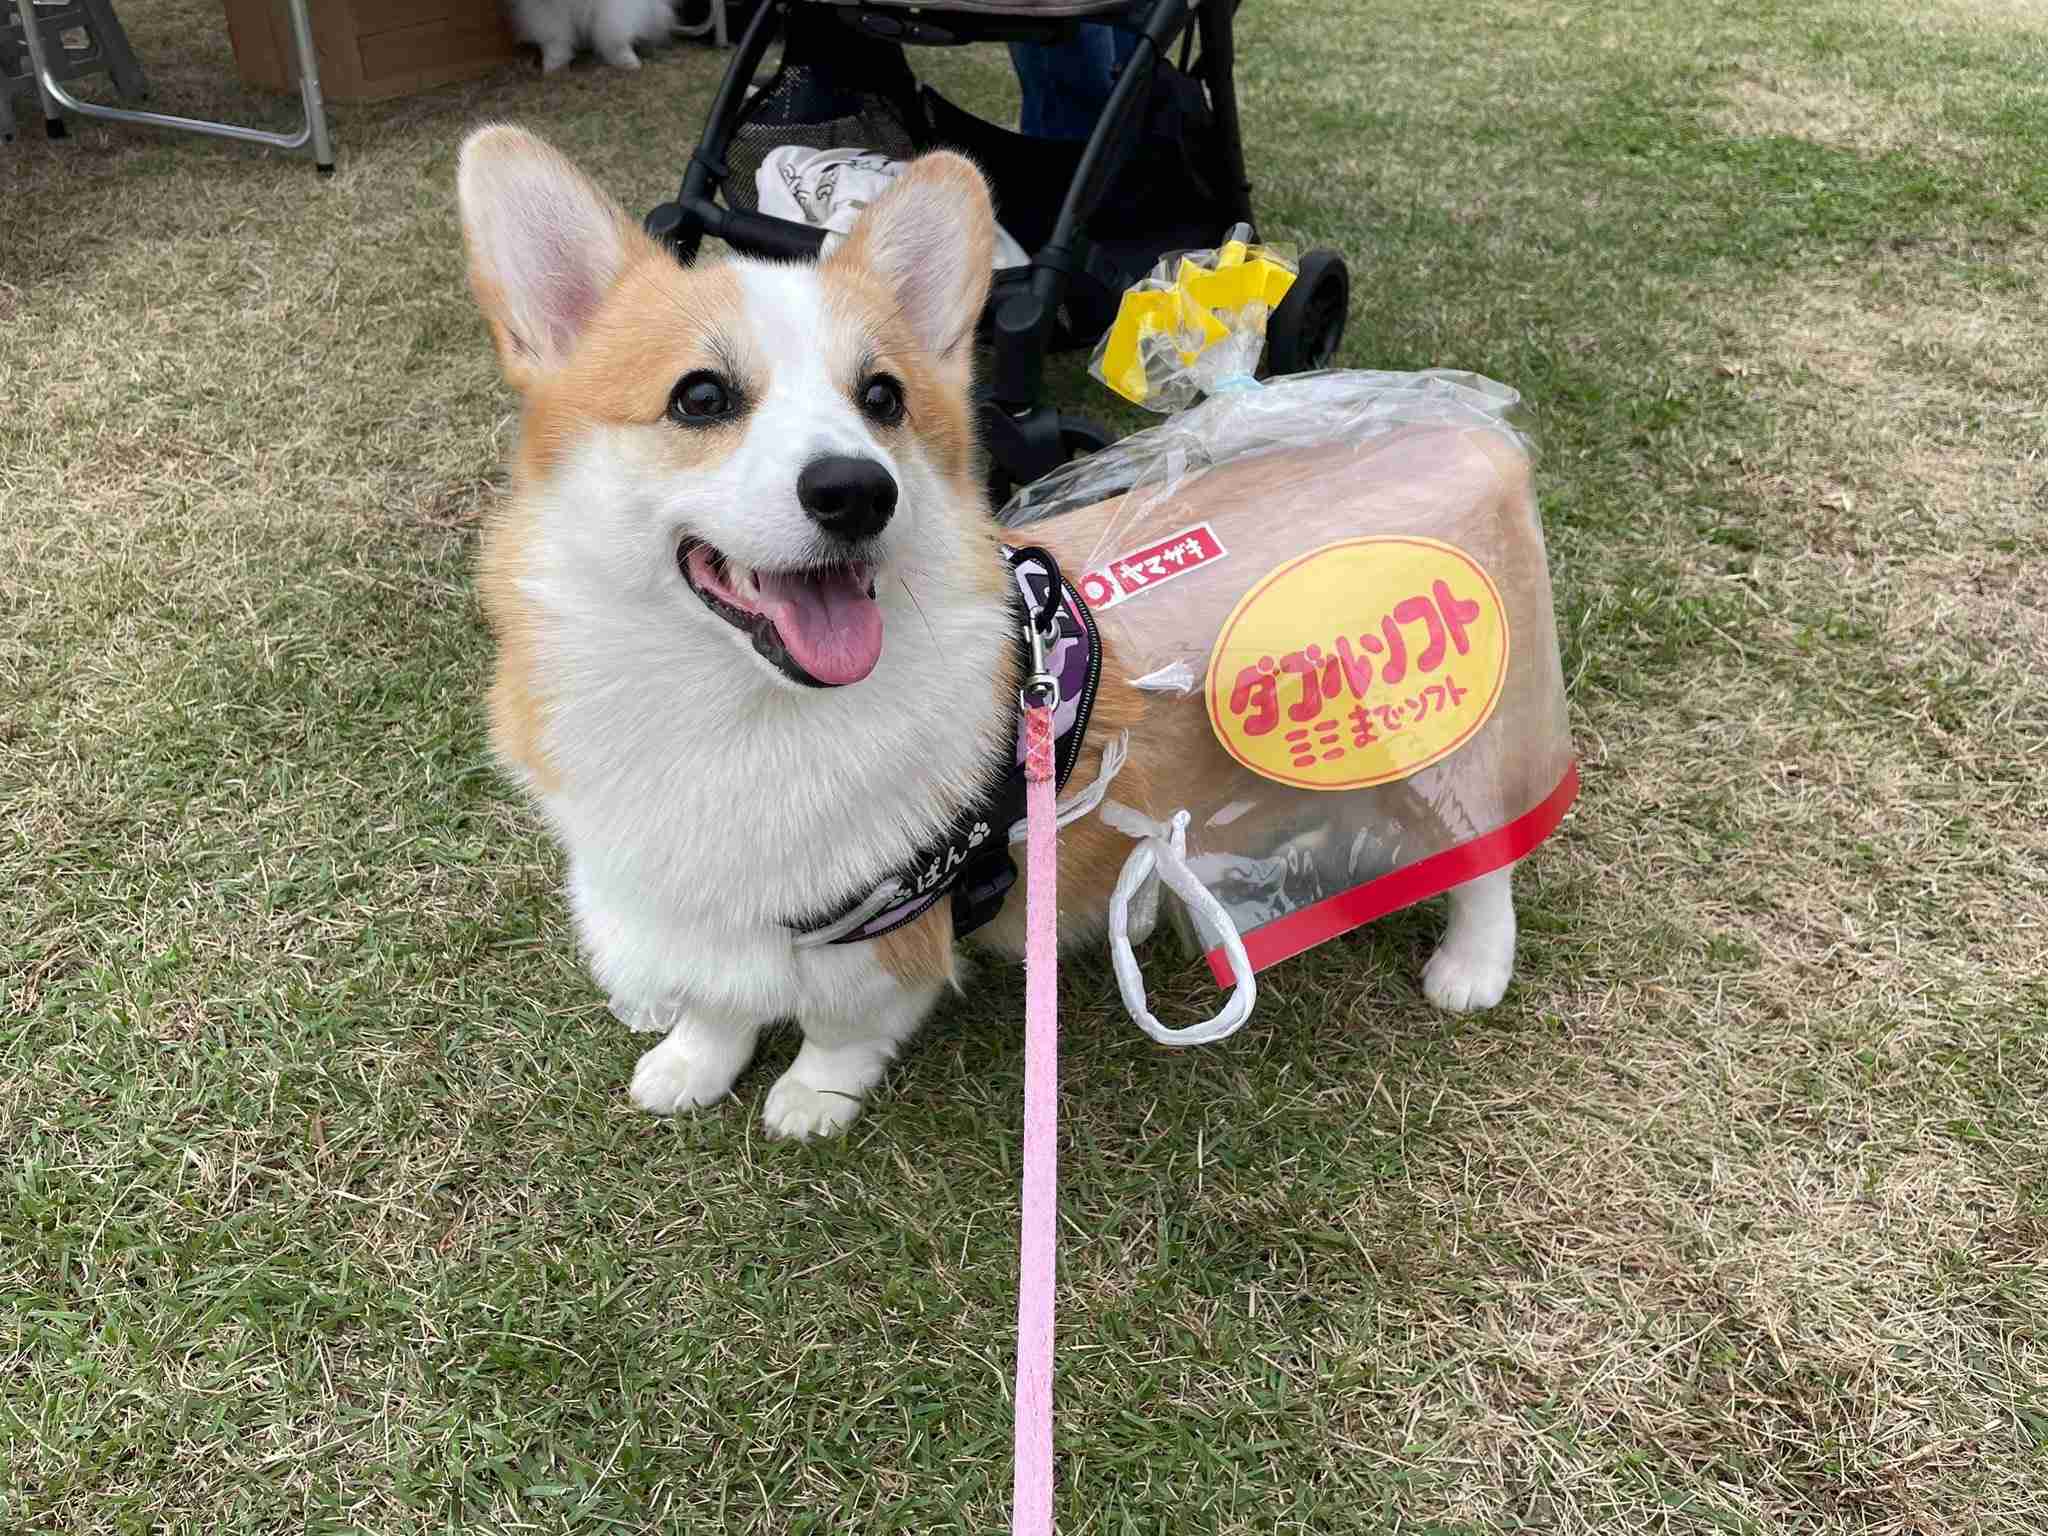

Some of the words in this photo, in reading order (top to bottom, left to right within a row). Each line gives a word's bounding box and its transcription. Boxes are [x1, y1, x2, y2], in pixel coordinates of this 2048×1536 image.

[1119, 537, 1205, 585] ヤマザキ
[1230, 579, 1479, 736] ダブルソフト
